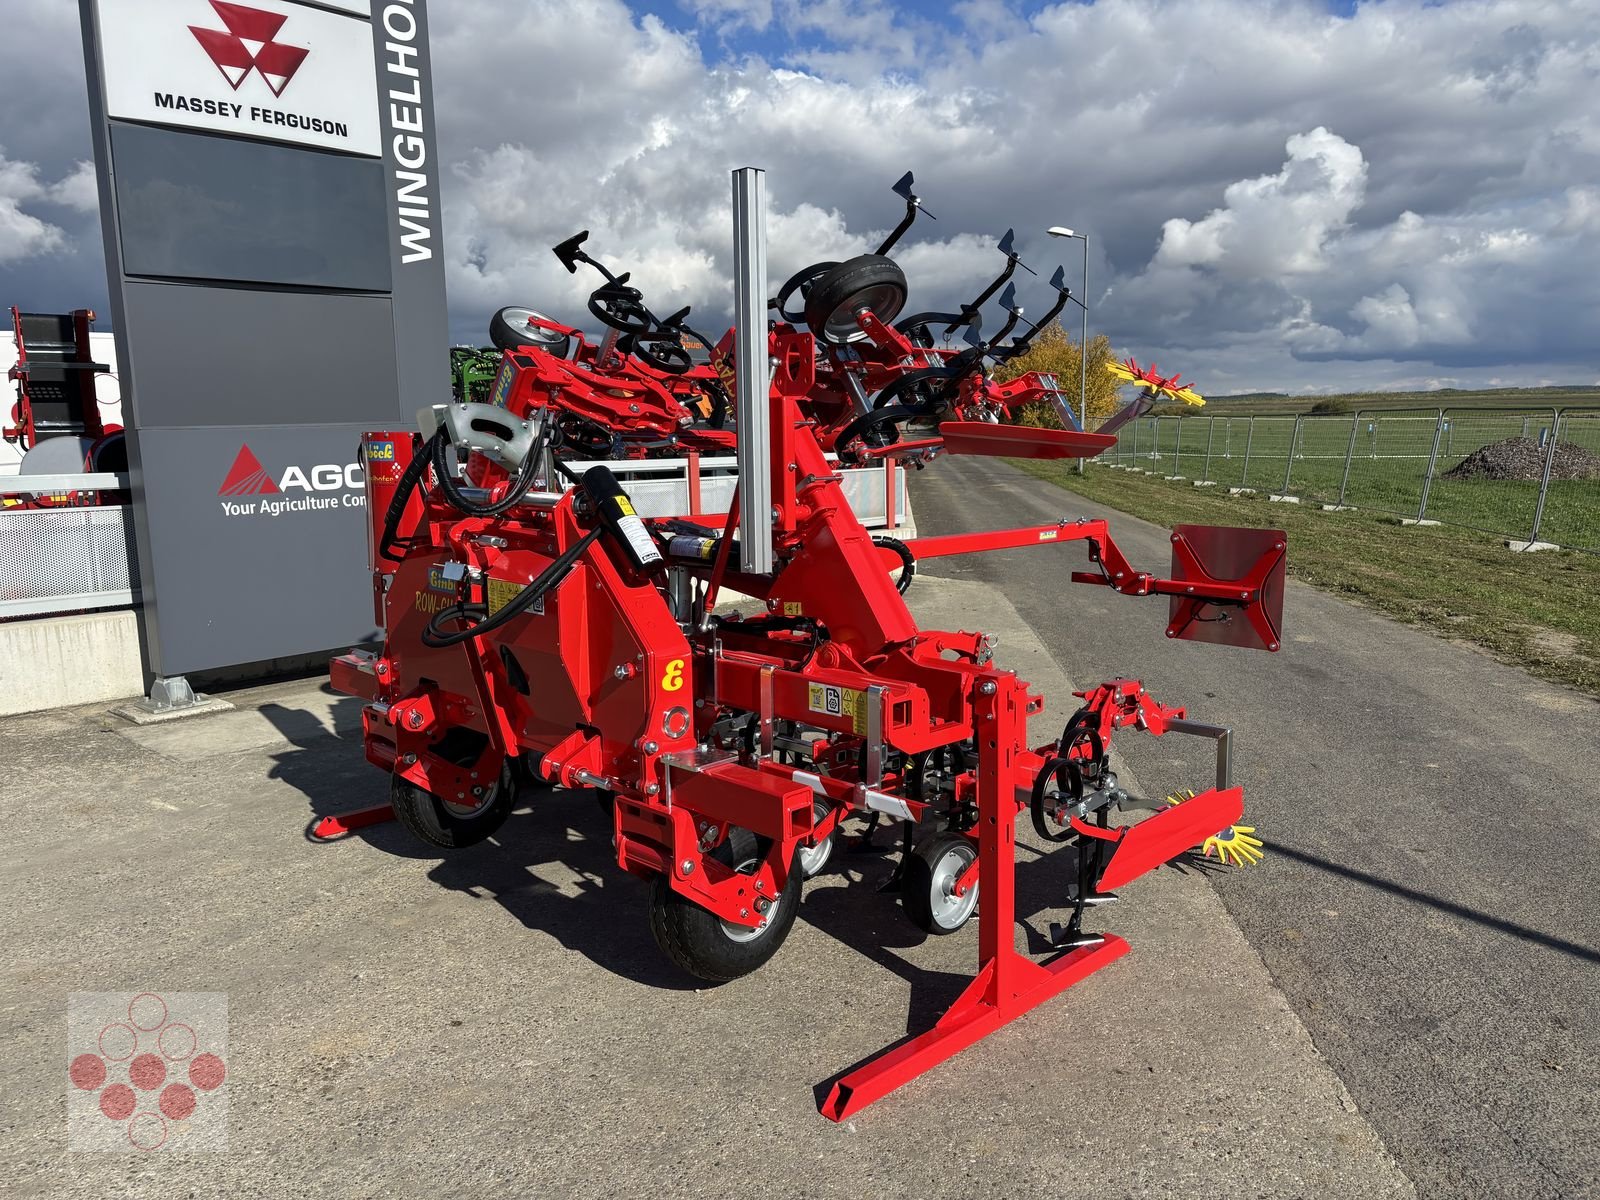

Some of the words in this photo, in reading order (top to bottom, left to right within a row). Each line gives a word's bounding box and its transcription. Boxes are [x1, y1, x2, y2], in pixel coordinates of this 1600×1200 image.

[154, 92, 243, 118] MASSEY
[250, 106, 348, 138] FERGUSON
[383, 0, 433, 264] WINGELHO
[221, 501, 256, 517] Your
[260, 495, 339, 516] Agriculture
